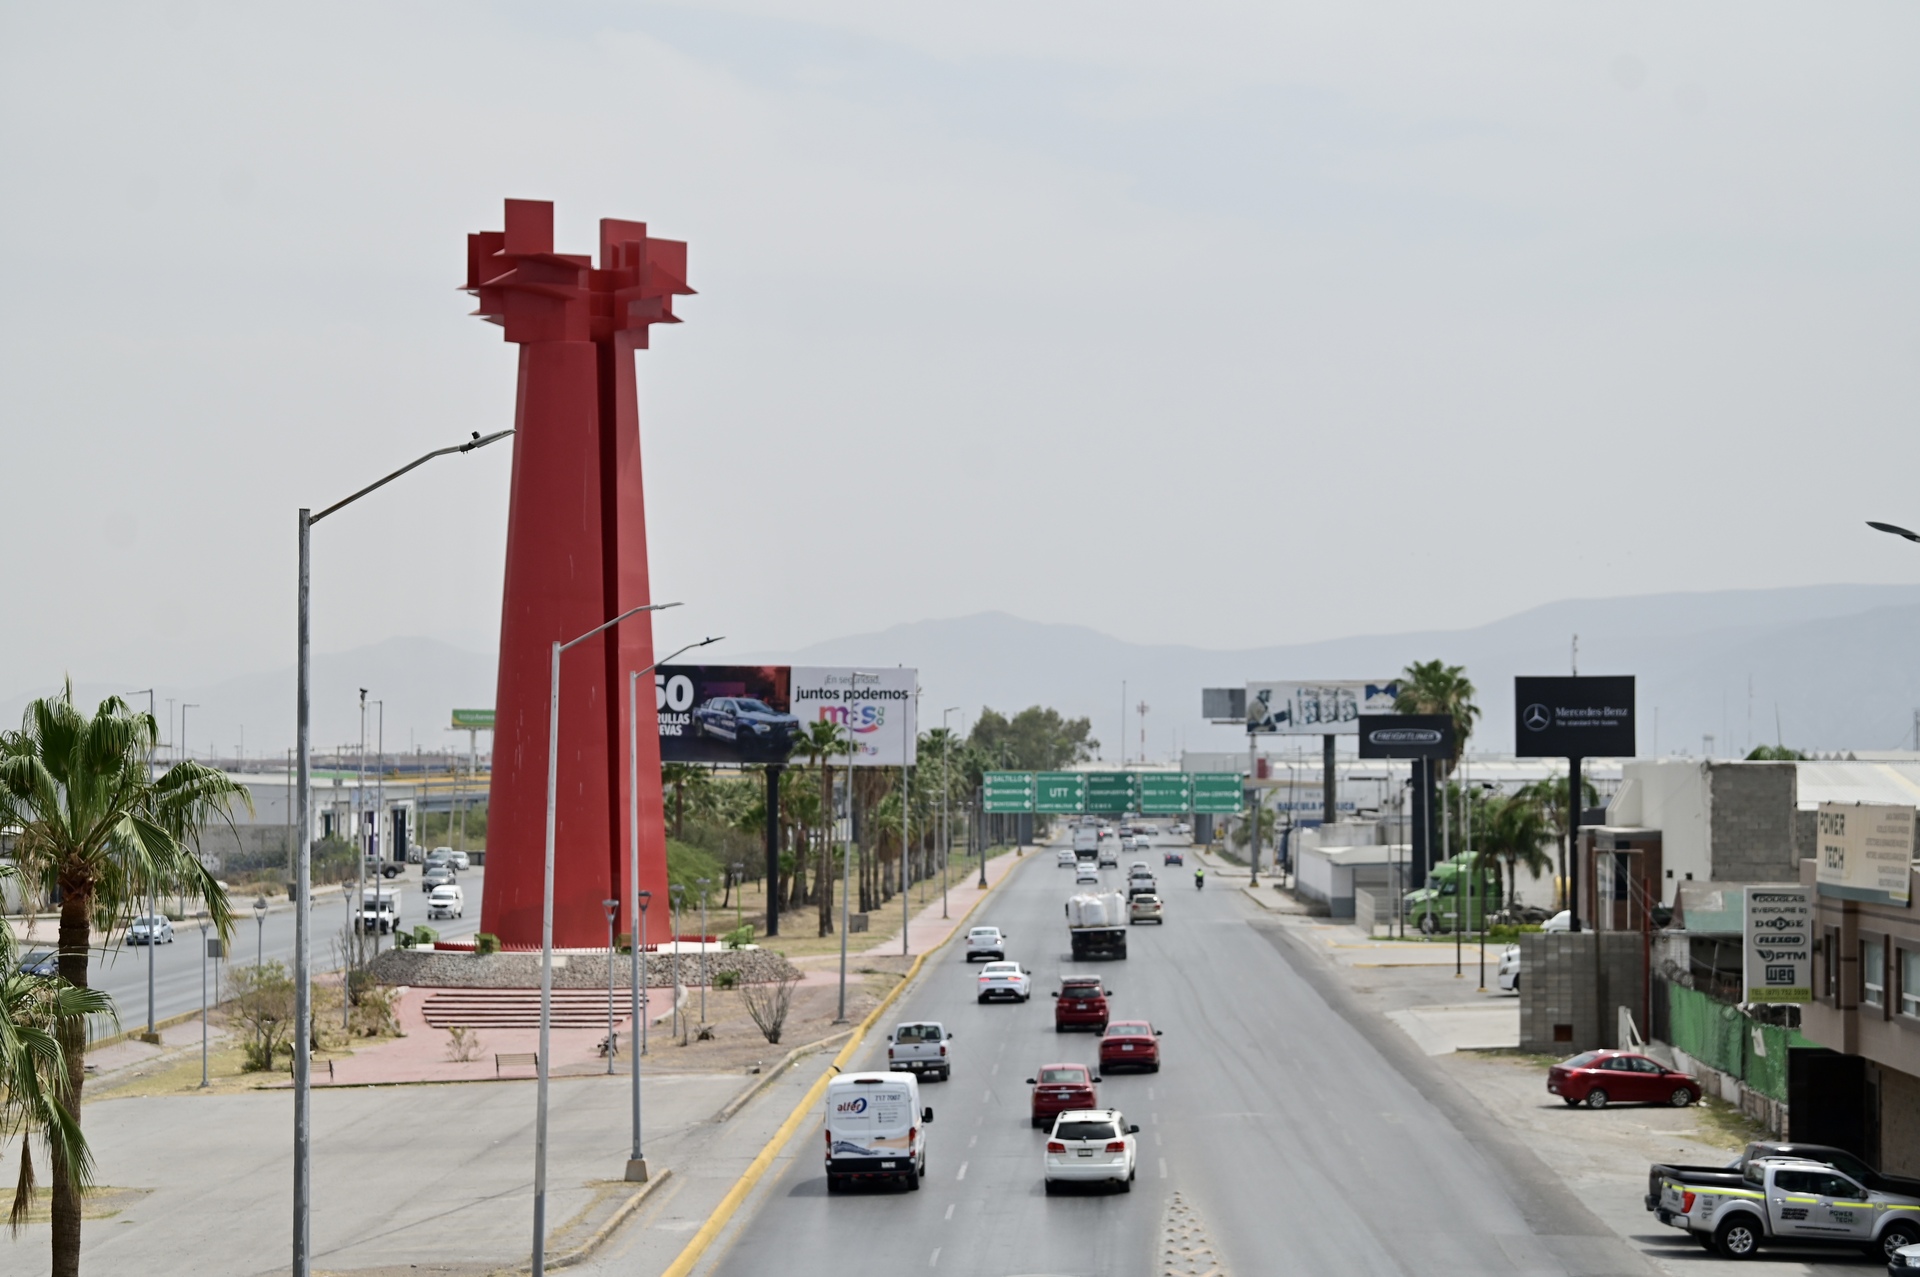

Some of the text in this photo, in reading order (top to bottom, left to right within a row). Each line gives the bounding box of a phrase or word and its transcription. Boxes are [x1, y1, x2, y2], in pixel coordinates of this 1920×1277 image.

[795, 686, 909, 702] juntos podemos
[658, 724, 683, 736] EVAS
[993, 775, 1023, 783] SALTILLO
[1049, 787, 1069, 798] UTT
[1819, 812, 1845, 836] POWER
[1825, 846, 1844, 870] TECH
[1755, 919, 1804, 928] DODGE
[1776, 951, 1806, 960] PTM
[837, 1101, 861, 1112] alfer
